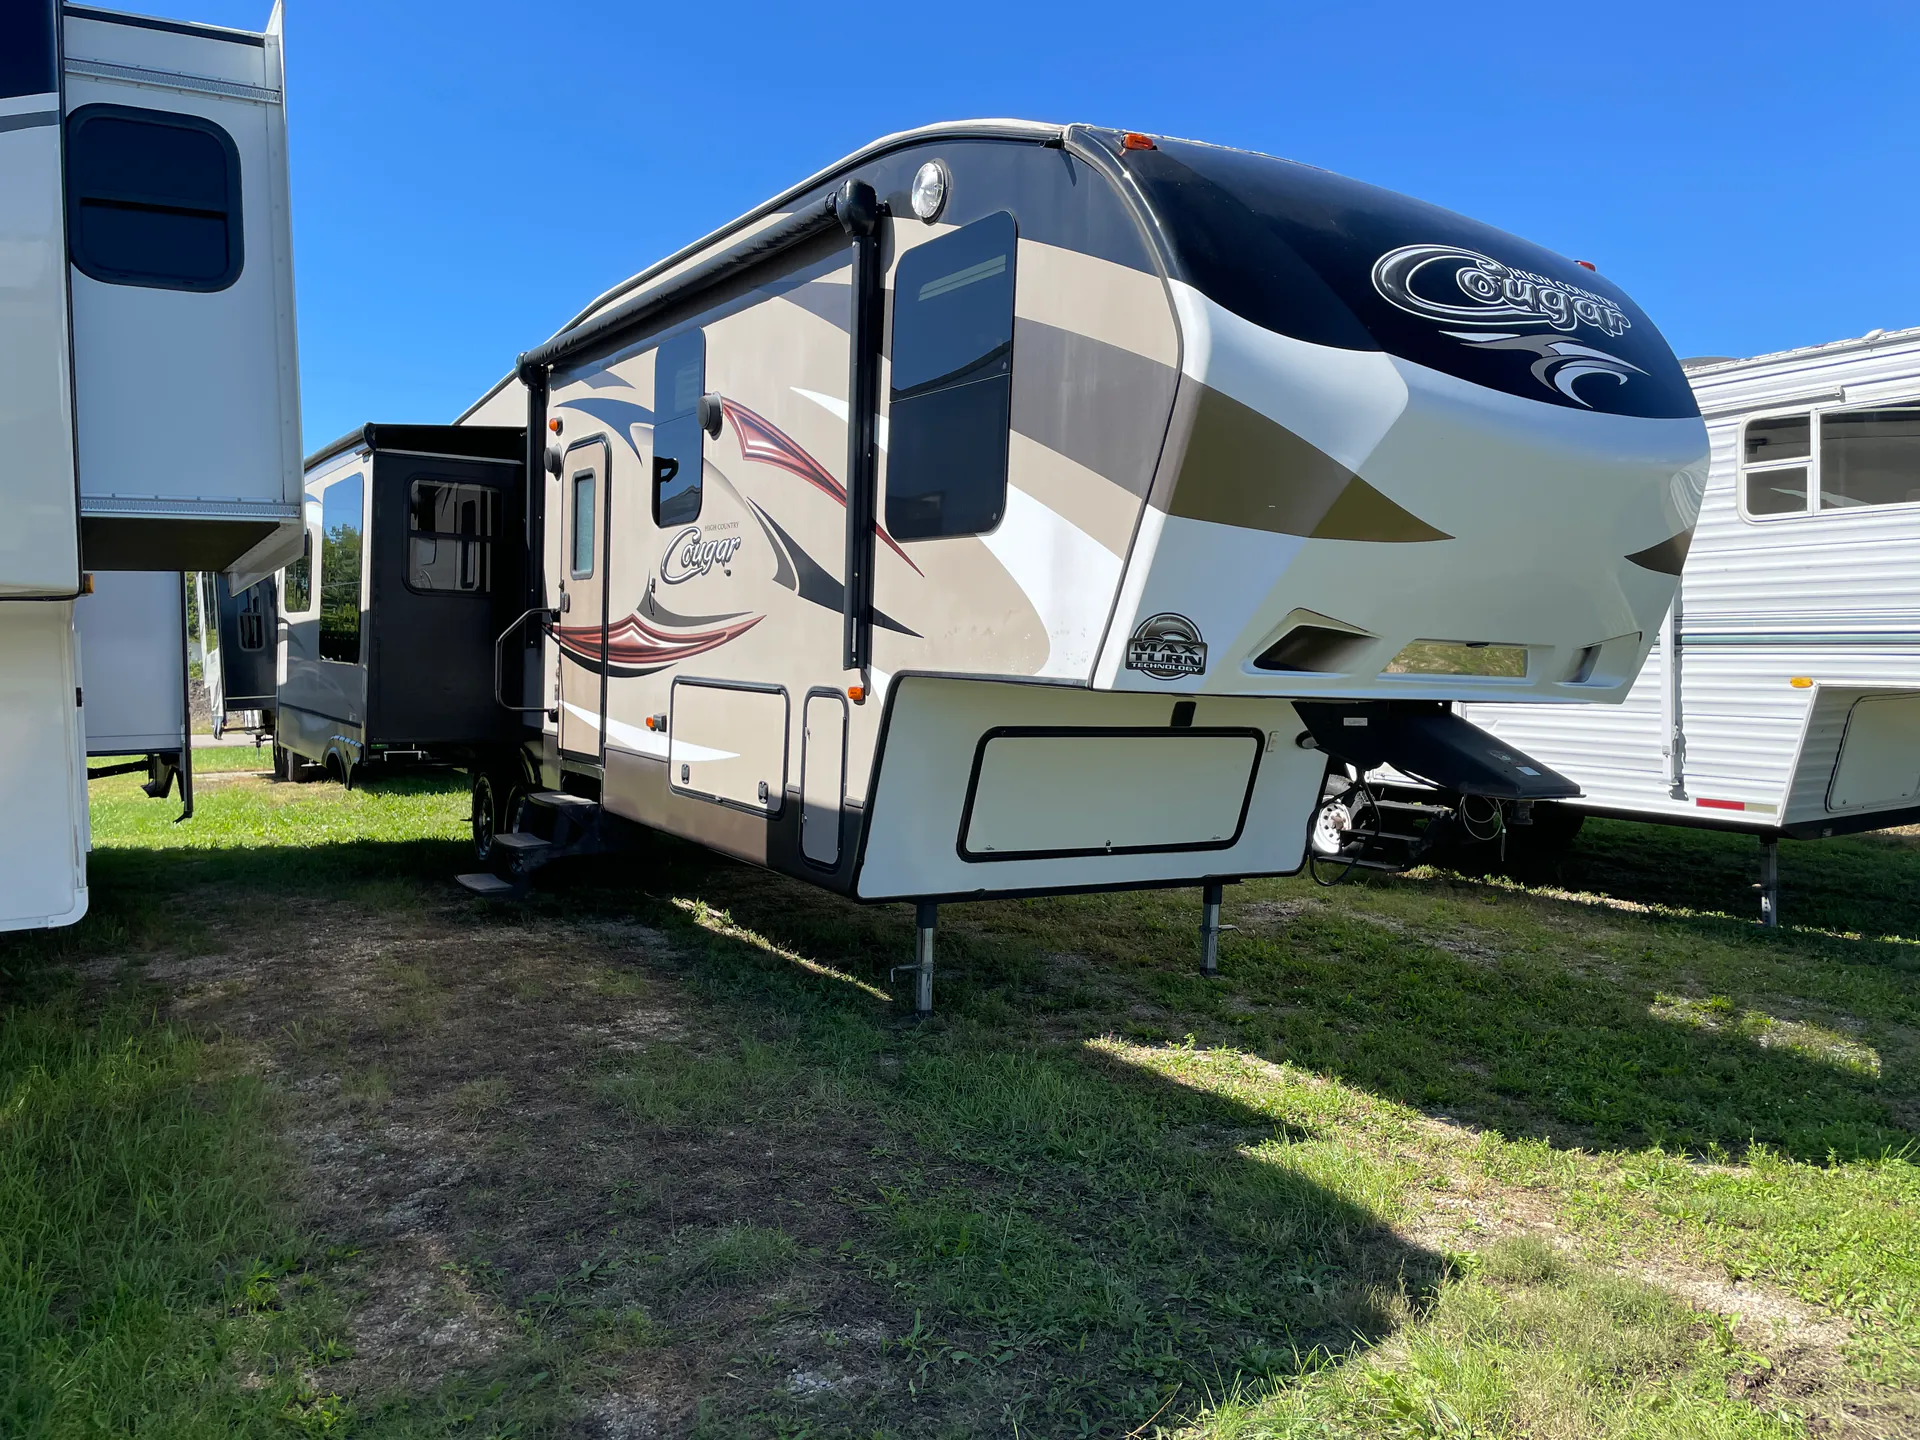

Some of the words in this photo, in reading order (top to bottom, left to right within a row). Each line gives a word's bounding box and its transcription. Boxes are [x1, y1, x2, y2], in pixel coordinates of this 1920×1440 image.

[1371, 244, 1632, 338] Cougar
[1508, 266, 1557, 288] HIGH
[1555, 280, 1623, 312] COUNTRY
[704, 524, 717, 532] HIGH
[717, 521, 739, 530] COUNTRY
[660, 526, 741, 585] Cougar
[1134, 642, 1199, 655] MAX
[1131, 652, 1202, 666] TURN
[1131, 662, 1200, 672] TECHNOLOGY
